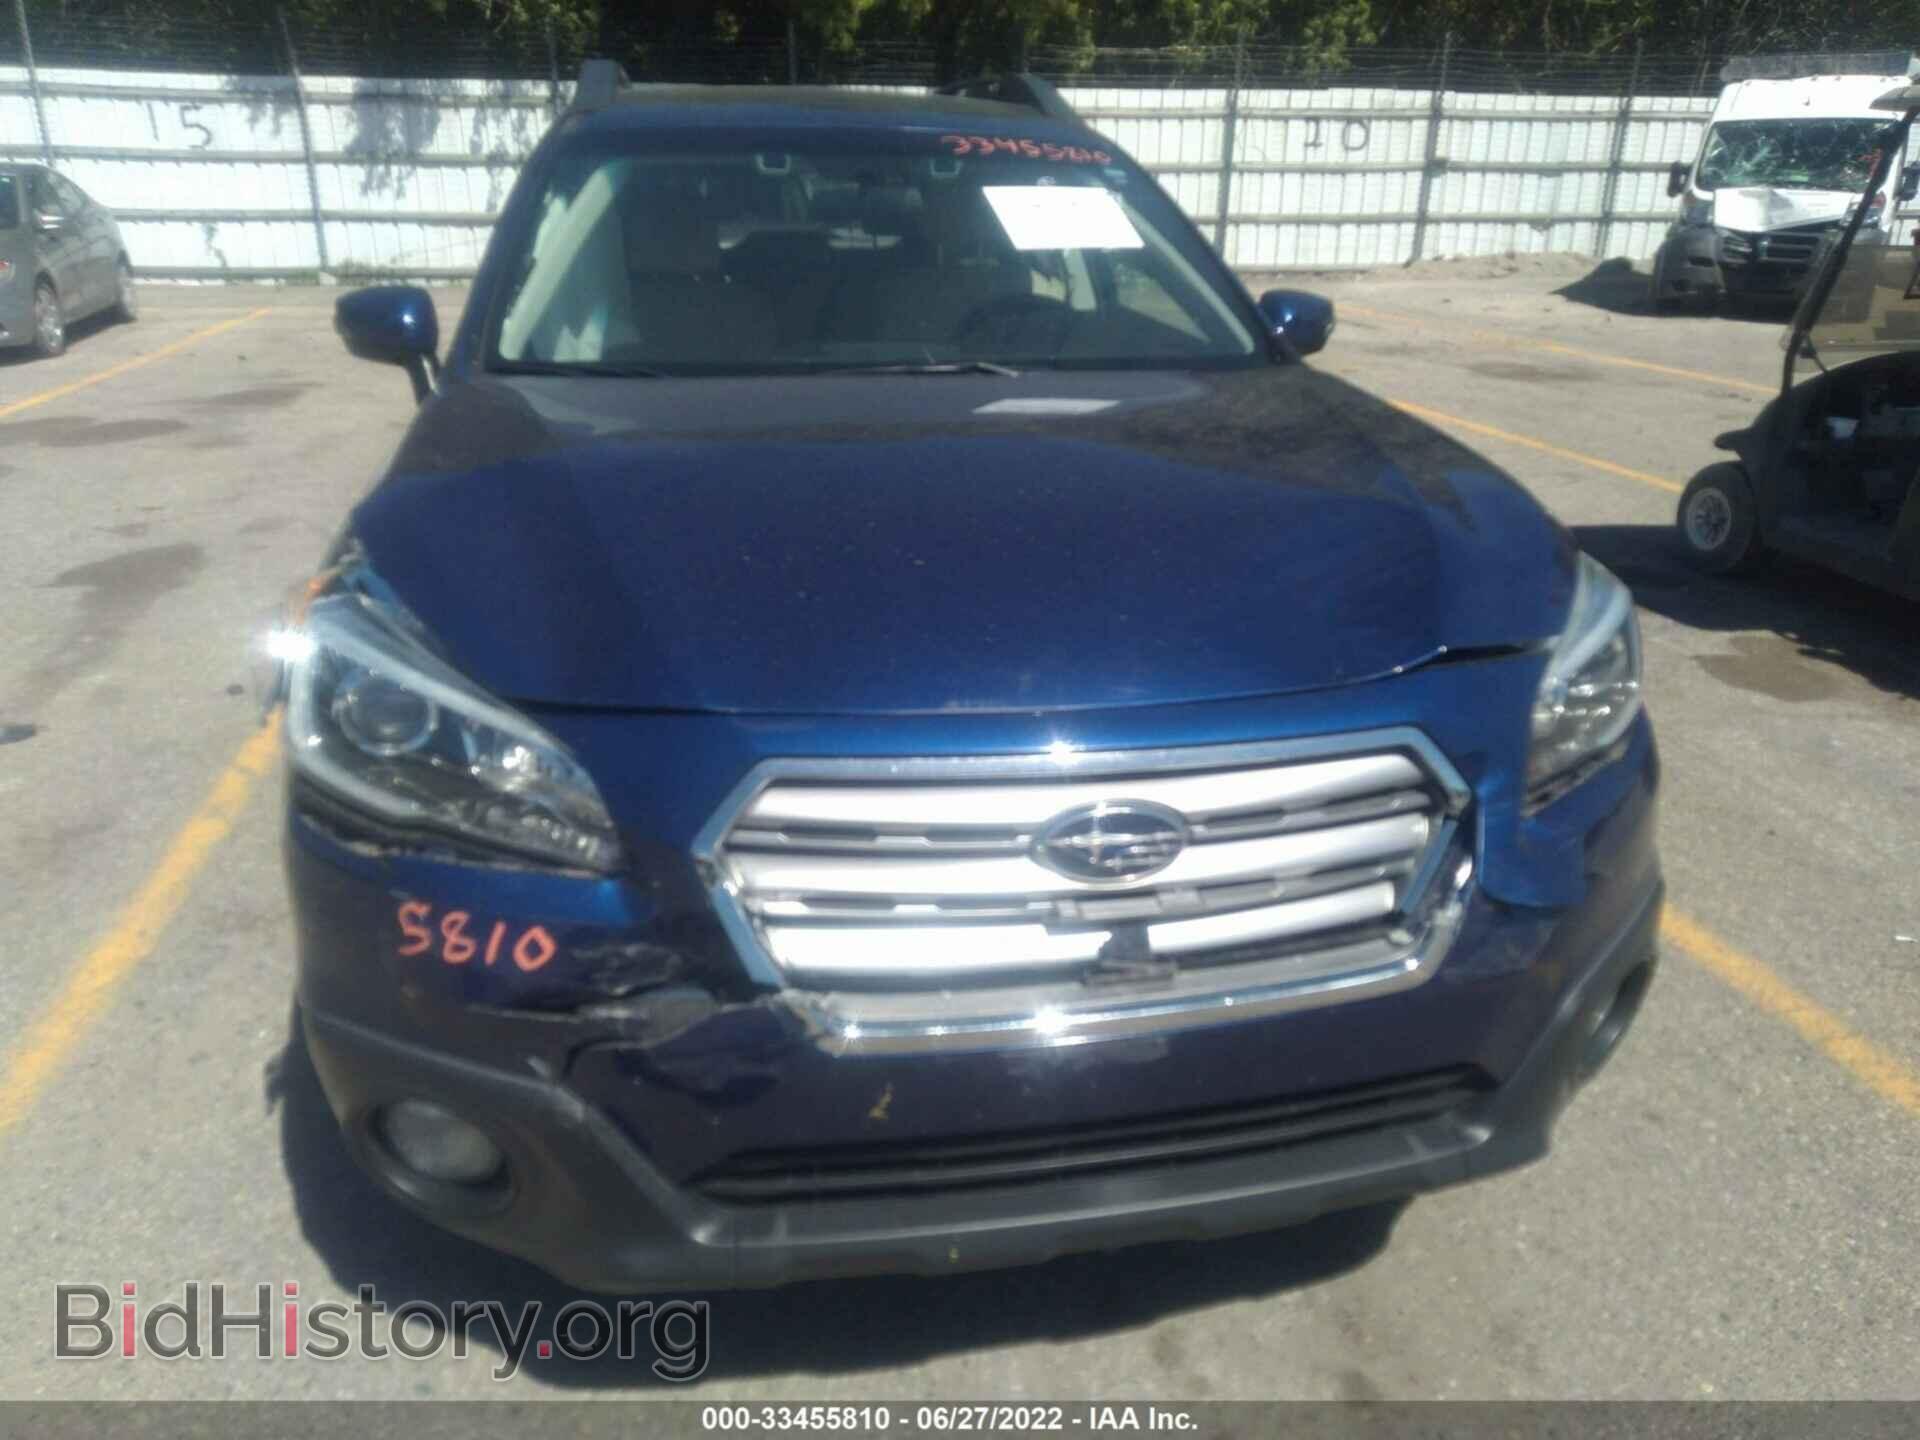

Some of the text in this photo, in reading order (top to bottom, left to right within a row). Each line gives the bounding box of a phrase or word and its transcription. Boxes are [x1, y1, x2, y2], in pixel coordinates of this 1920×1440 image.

[147, 103, 213, 150] 15
[1304, 118, 1370, 151] 10
[398, 901, 557, 972] 5810
